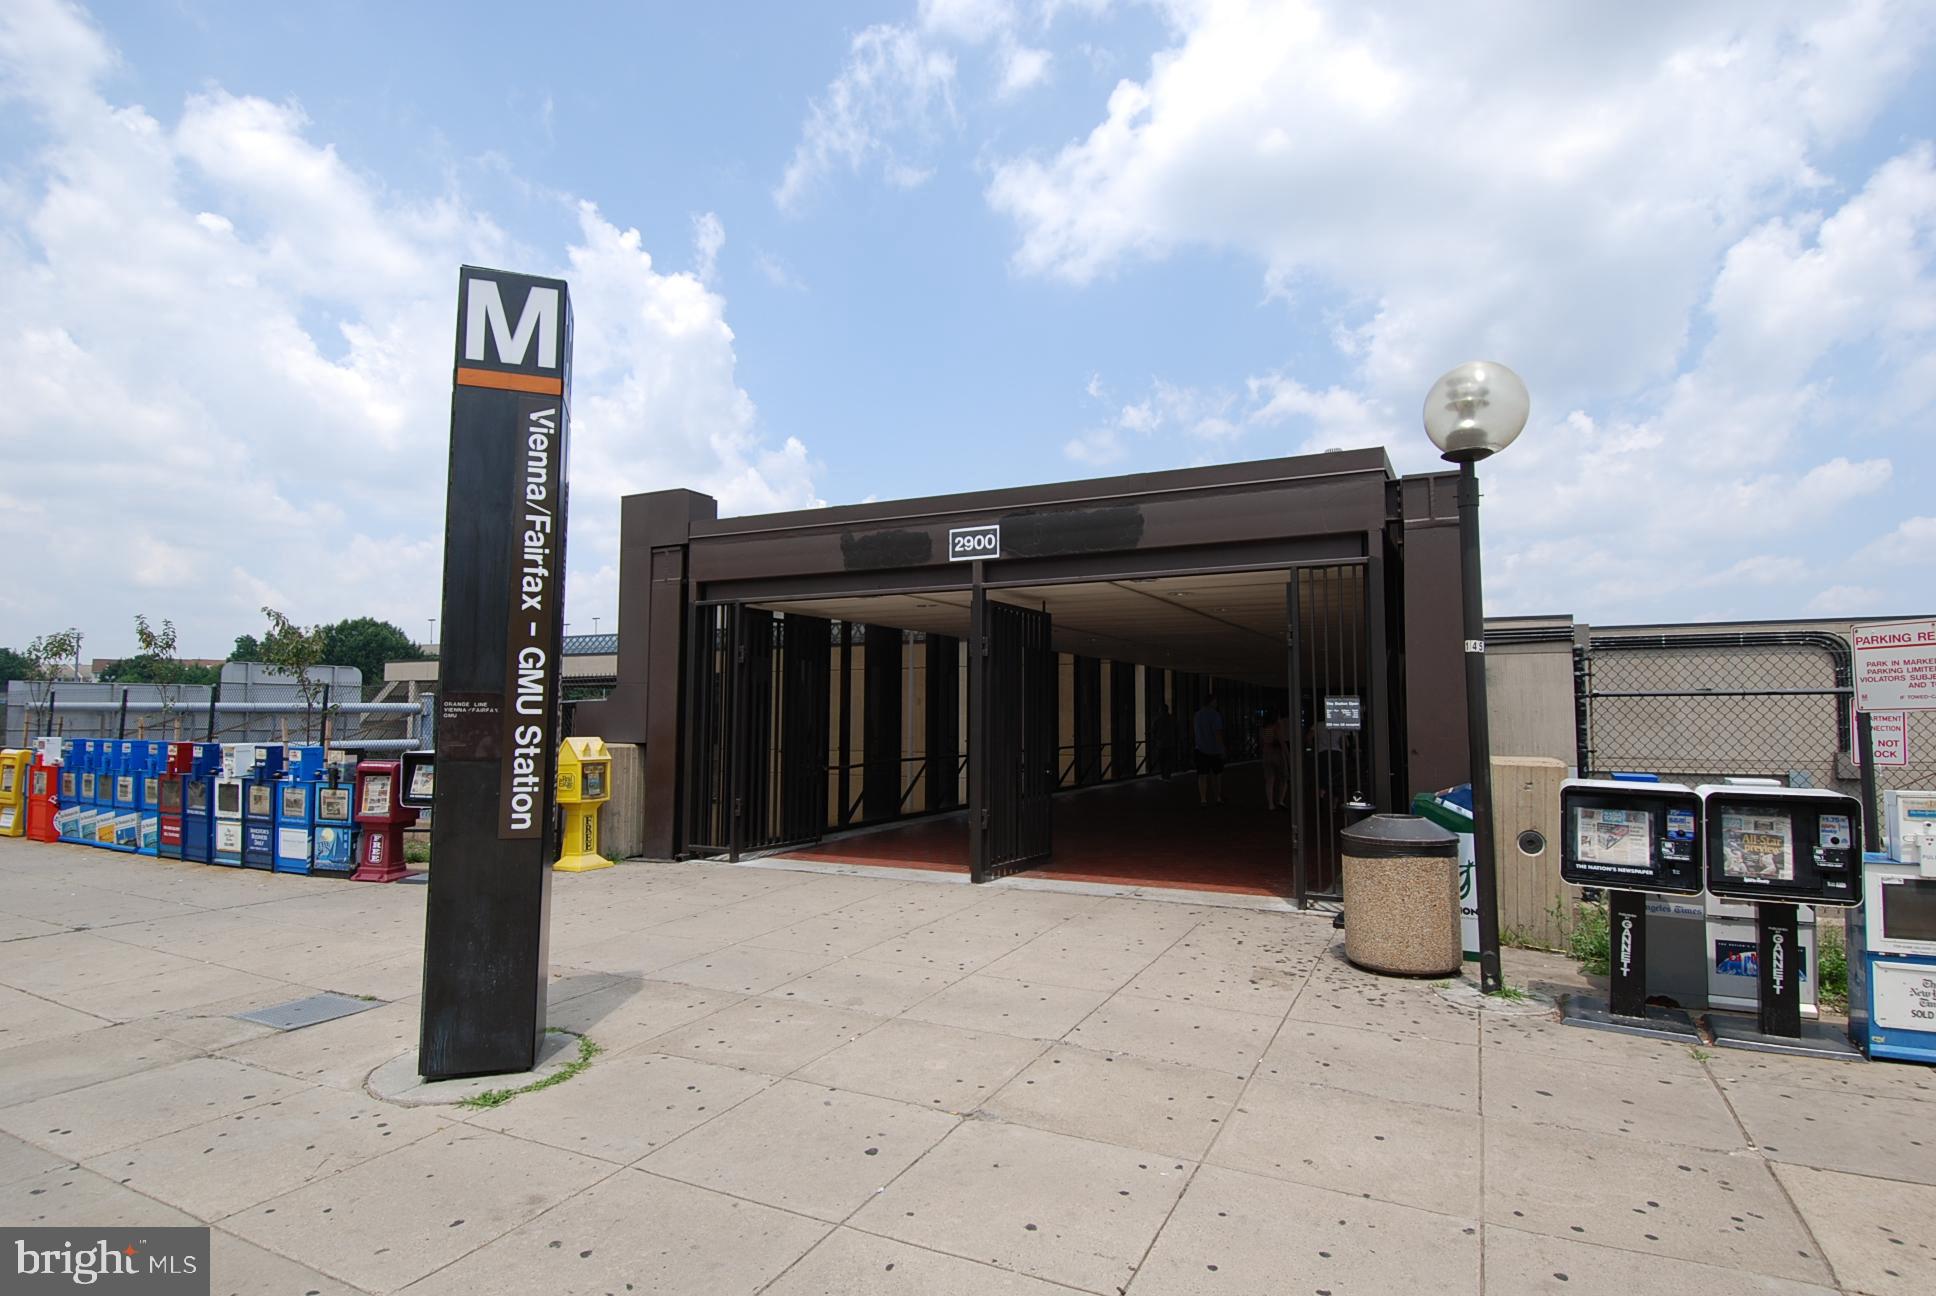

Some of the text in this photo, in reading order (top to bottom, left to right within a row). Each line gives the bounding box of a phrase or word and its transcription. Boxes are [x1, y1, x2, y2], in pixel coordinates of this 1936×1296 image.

[465, 278, 559, 369] M
[521, 408, 556, 611] Vienna/Fairfax
[954, 533, 996, 552] 2900
[1855, 632, 1912, 646] PARKING
[1866, 660, 1888, 668] PARK
[1903, 658, 1936, 666] MARKE
[1867, 667, 1904, 675] PARKING
[514, 646, 546, 716] GMU
[1860, 674, 1906, 683] VIOLATORS
[1877, 739, 1900, 748] NOT
[1873, 750, 1897, 758] OCK
[510, 724, 543, 831] Station
[584, 816, 593, 852] FREE
[1742, 833, 1783, 847] All-Star
[370, 833, 383, 863] FREE
[1743, 843, 1783, 856] preview
[1588, 865, 1617, 873] NATION'S
[1617, 867, 1654, 876] NEWSPAPER
[1460, 906, 1480, 916] ION
[1645, 903, 1703, 915] ngeles Times
[1620, 919, 1633, 977] GANNETT
[1772, 933, 1785, 995] GANNETT
[1911, 1009, 1935, 1020] SOLD
